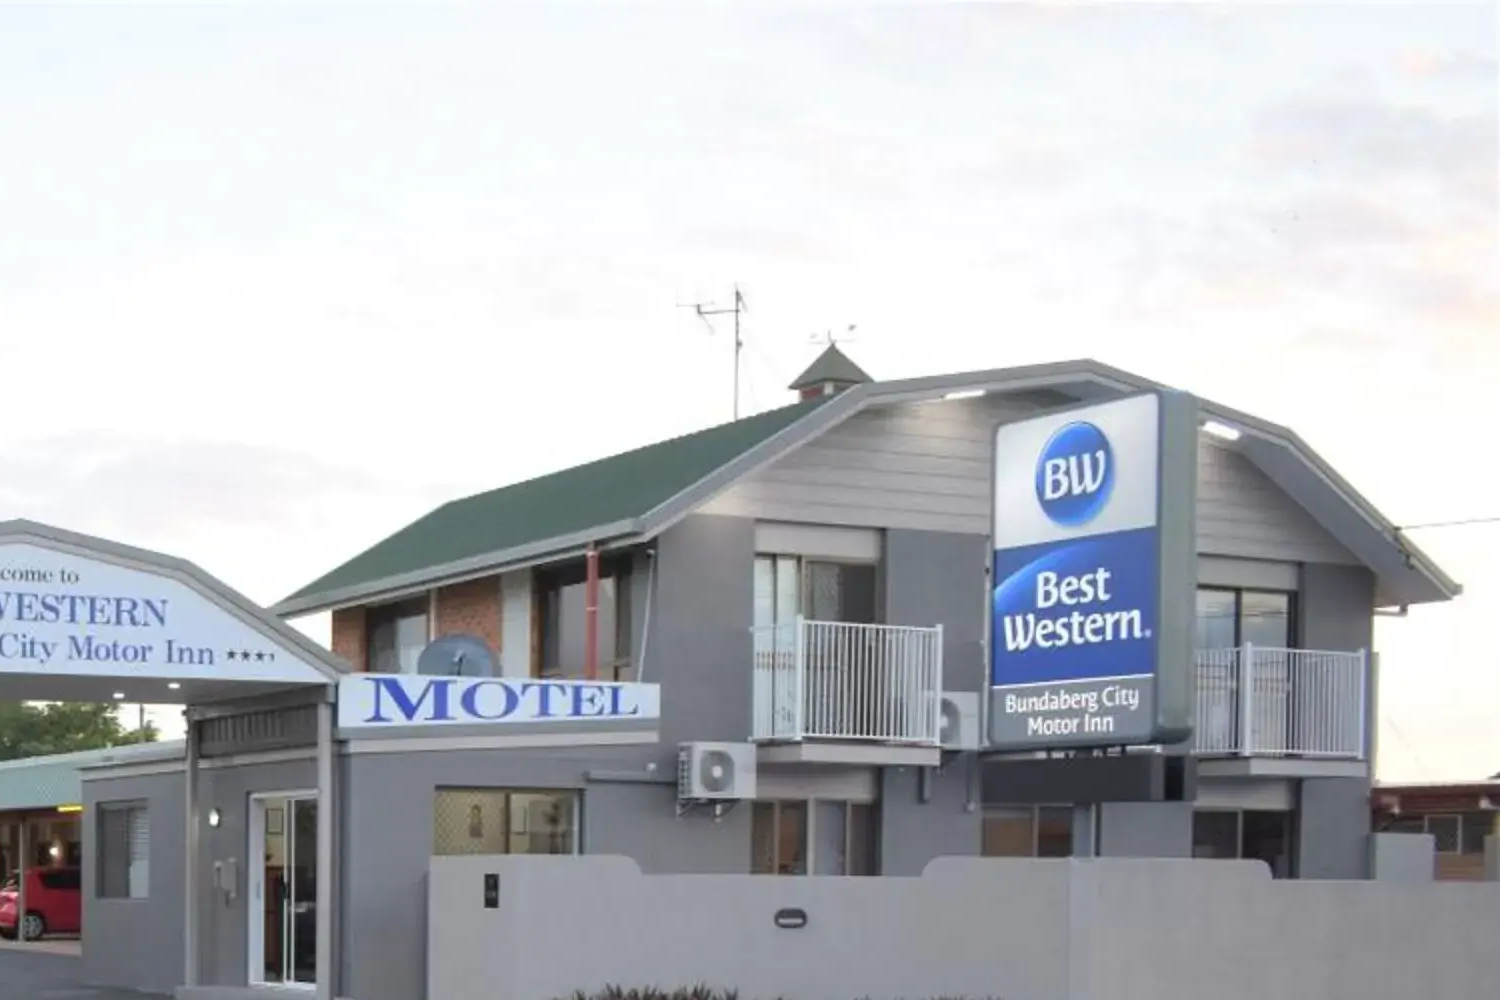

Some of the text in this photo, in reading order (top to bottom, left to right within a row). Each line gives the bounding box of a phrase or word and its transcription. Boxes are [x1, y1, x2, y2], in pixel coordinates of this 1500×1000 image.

[1044, 450, 1105, 499] BW
[60, 568, 80, 584] to
[1037, 567, 1111, 608] Best
[68, 635, 153, 663] Motor
[164, 639, 214, 665] Inn
[363, 677, 638, 723] MOTEL
[1005, 685, 1139, 713] Bundaberg City
[1027, 714, 1114, 736] Motor Inn
